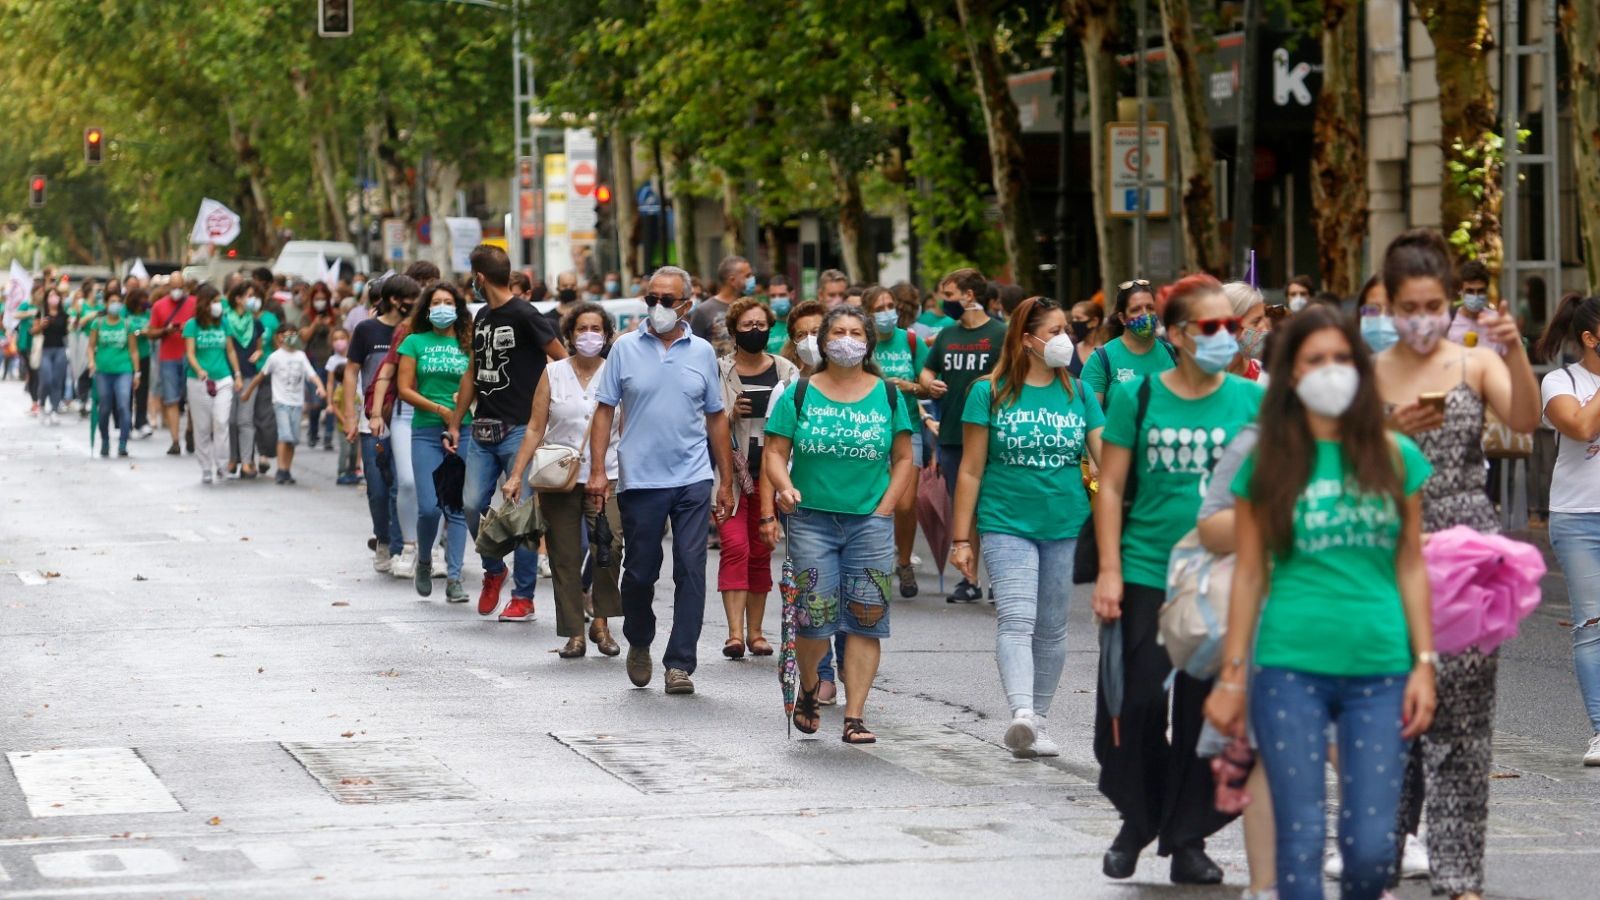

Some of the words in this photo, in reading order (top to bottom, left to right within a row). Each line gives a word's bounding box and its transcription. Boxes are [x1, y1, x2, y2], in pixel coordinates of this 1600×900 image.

[944, 353, 989, 371] SURF
[807, 405, 846, 420] ESCUELA
[997, 409, 1046, 425] ESCUELA
[811, 426, 829, 436] DE
[800, 444, 838, 455] PARA
[1007, 436, 1028, 450] DE
